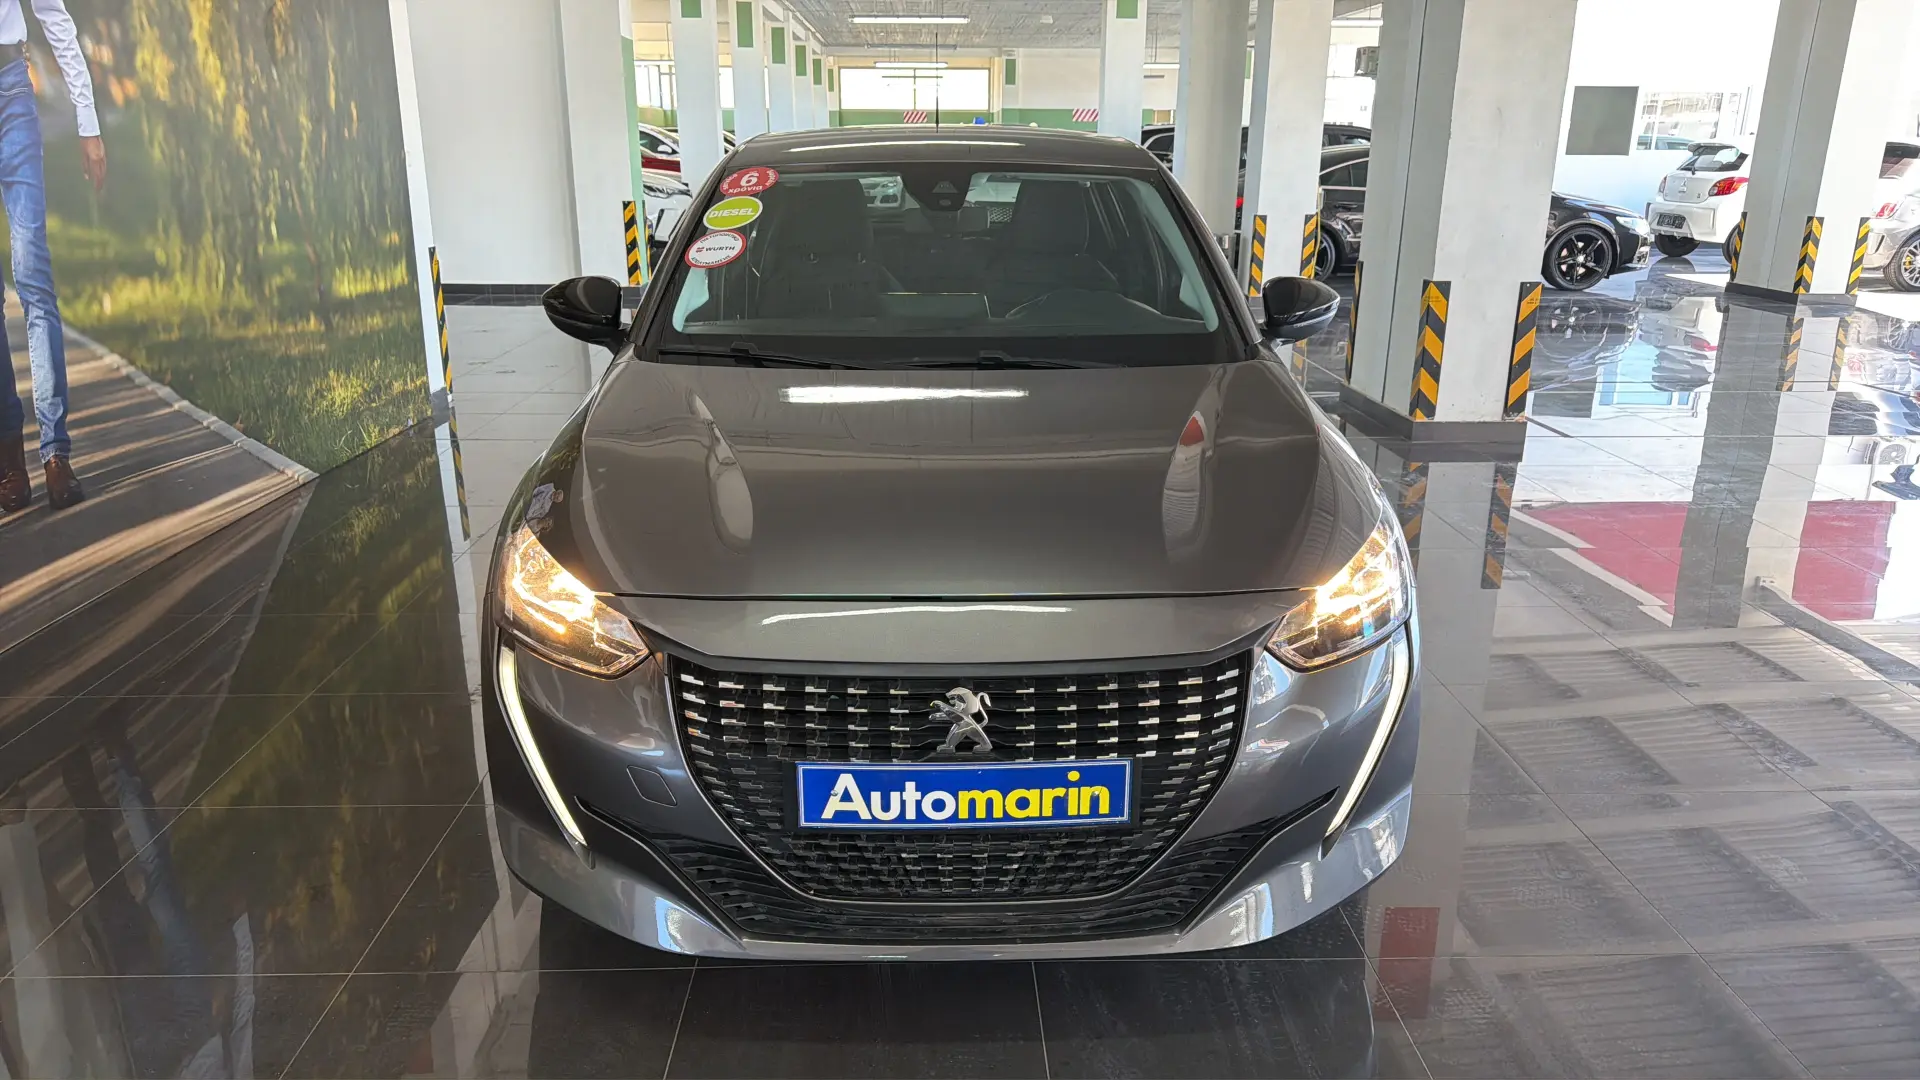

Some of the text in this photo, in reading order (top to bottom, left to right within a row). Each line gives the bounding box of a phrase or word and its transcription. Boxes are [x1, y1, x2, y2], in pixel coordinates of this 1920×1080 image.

[740, 172, 760, 187] 6
[728, 185, 763, 194] χρόνια
[709, 207, 755, 218] DIESEL
[821, 770, 1111, 822] Automarin
